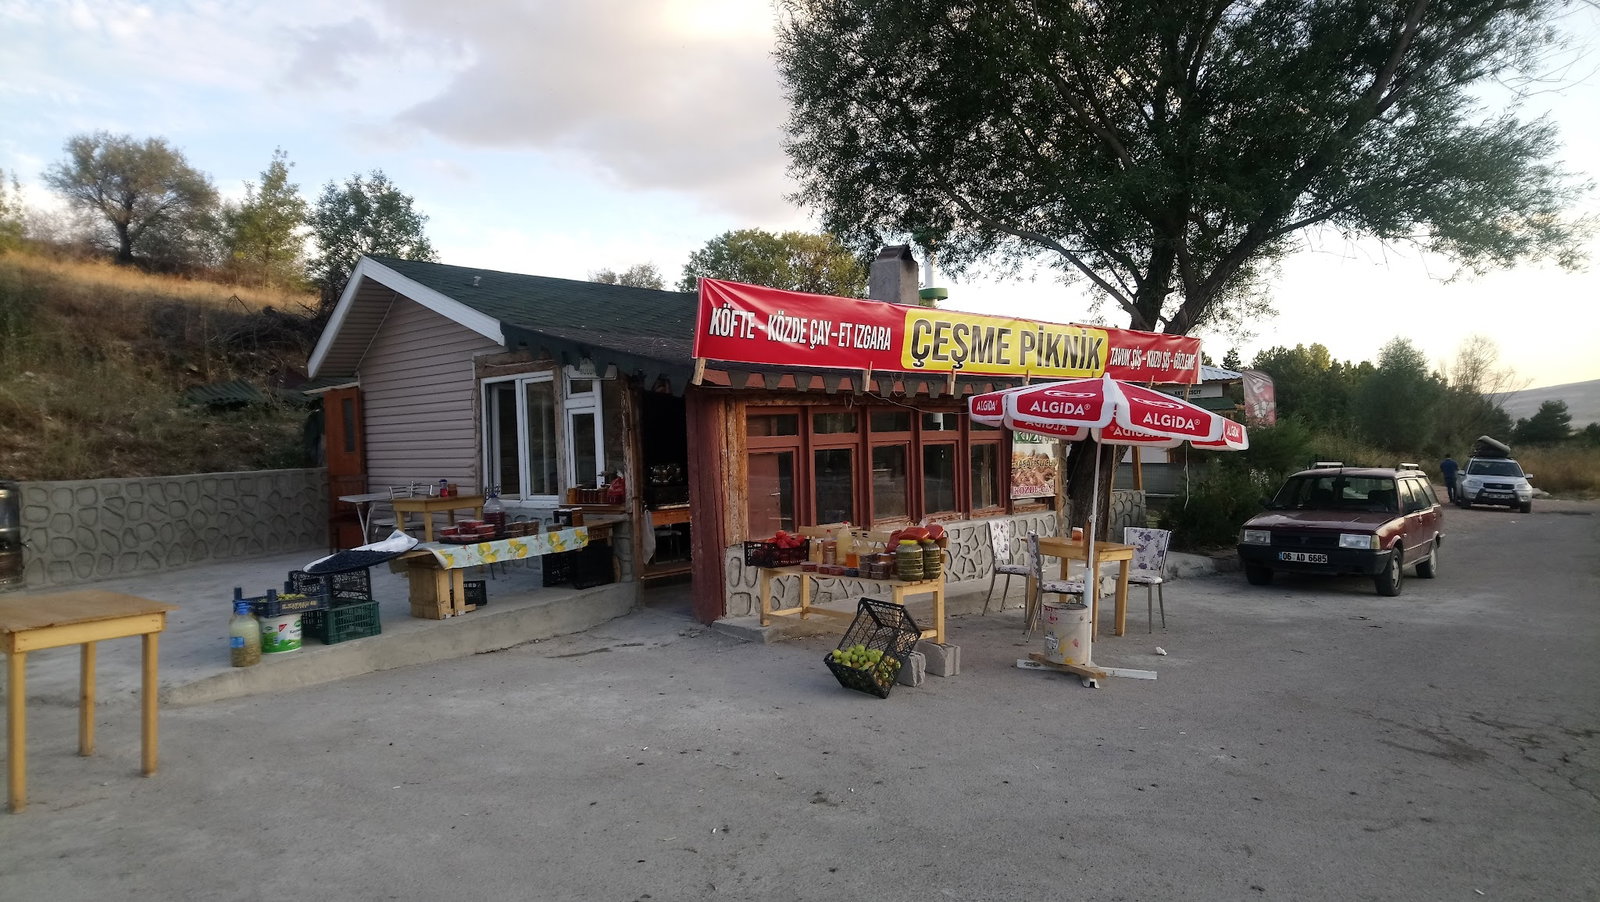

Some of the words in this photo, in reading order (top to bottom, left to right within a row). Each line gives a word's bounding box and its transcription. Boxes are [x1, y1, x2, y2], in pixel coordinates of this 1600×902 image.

[709, 303, 756, 339] KÖFTE
[767, 311, 808, 344] KÖZDE
[854, 323, 891, 351] IZGARA
[911, 319, 1012, 369] ÇEŞME
[1020, 325, 1103, 370] PİKNİK
[1109, 347, 1131, 366] TAVUK
[1297, 553, 1305, 561] AD
